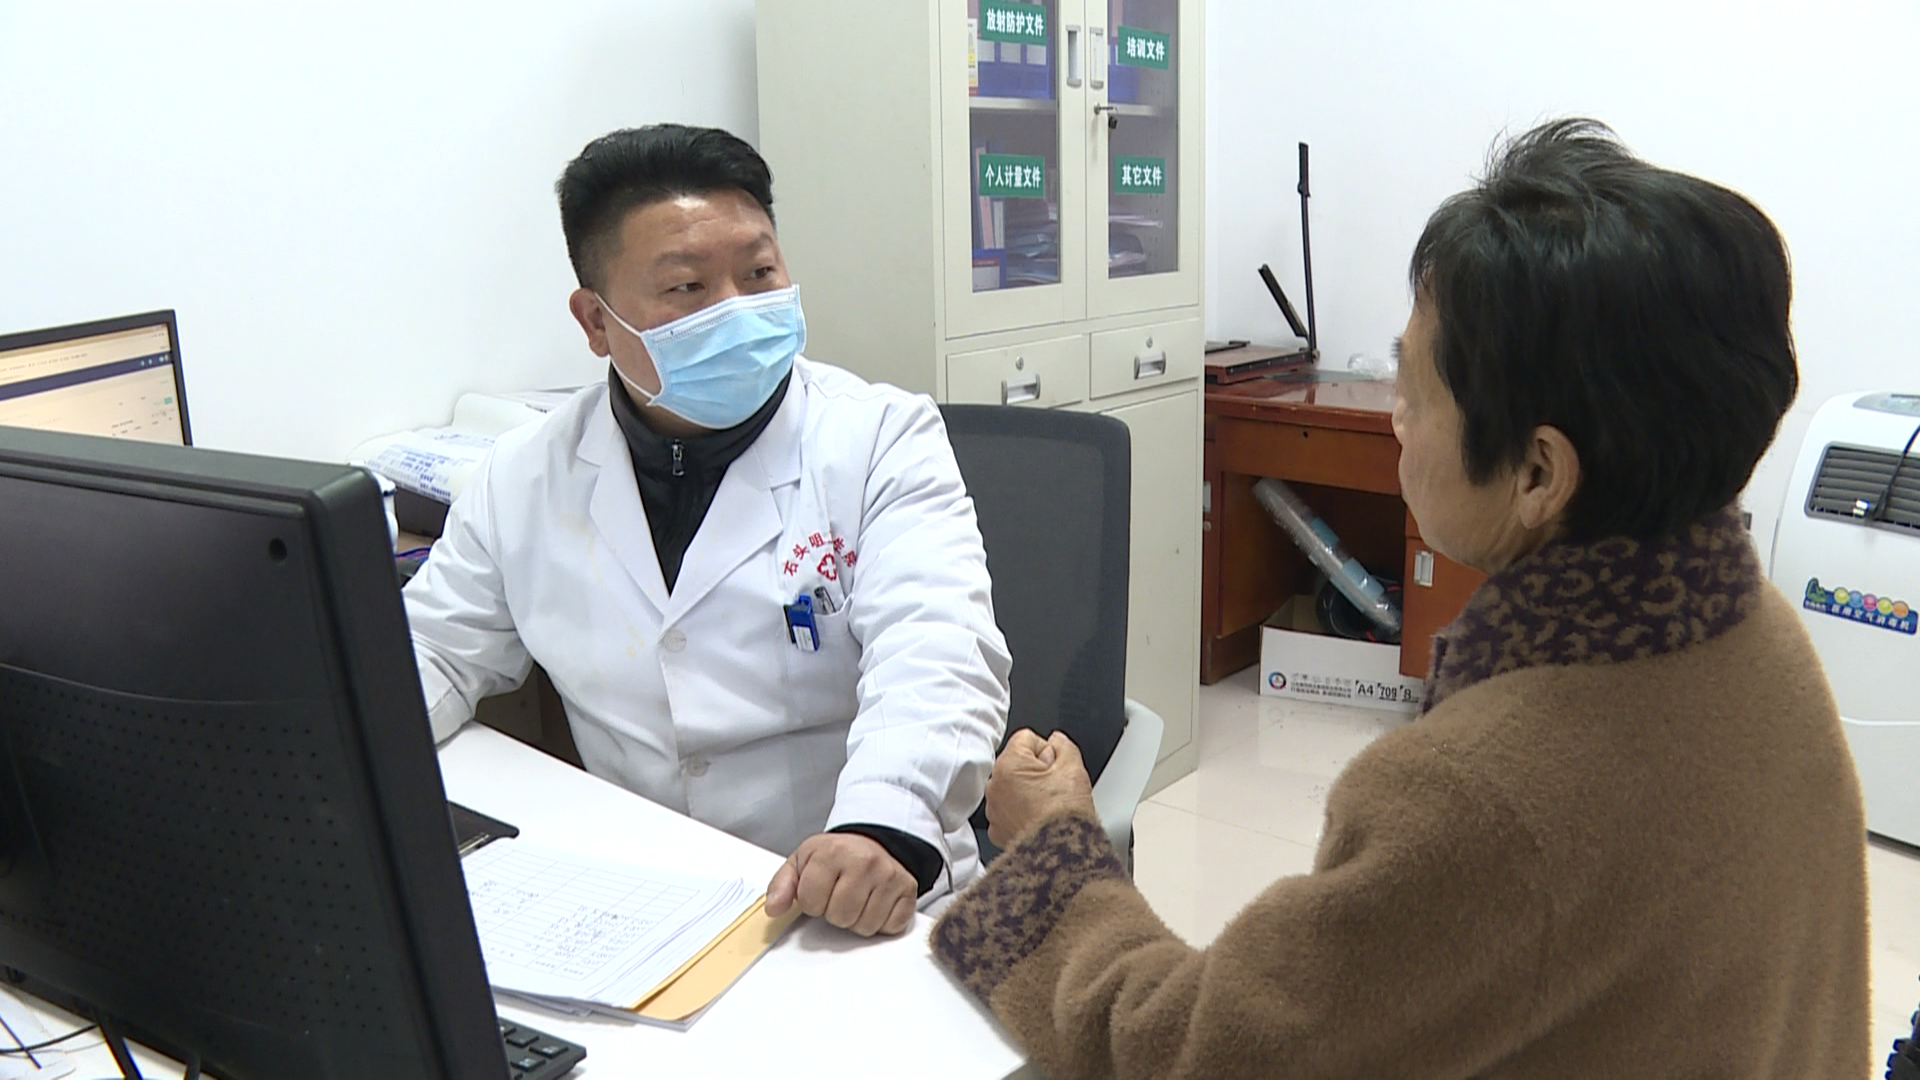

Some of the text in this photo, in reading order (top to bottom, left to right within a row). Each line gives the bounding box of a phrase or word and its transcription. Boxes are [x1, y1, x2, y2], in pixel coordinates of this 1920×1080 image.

[986, 8, 1044, 37] 放射防护文件
[1126, 37, 1165, 61] 培训文件
[985, 163, 1041, 188] 个人计量文件
[1122, 165, 1162, 187] 其它文件
[783, 532, 857, 576] 石头咀生院
[1831, 604, 1910, 630] 医用空气消毒机
[1357, 684, 1374, 696] A4
